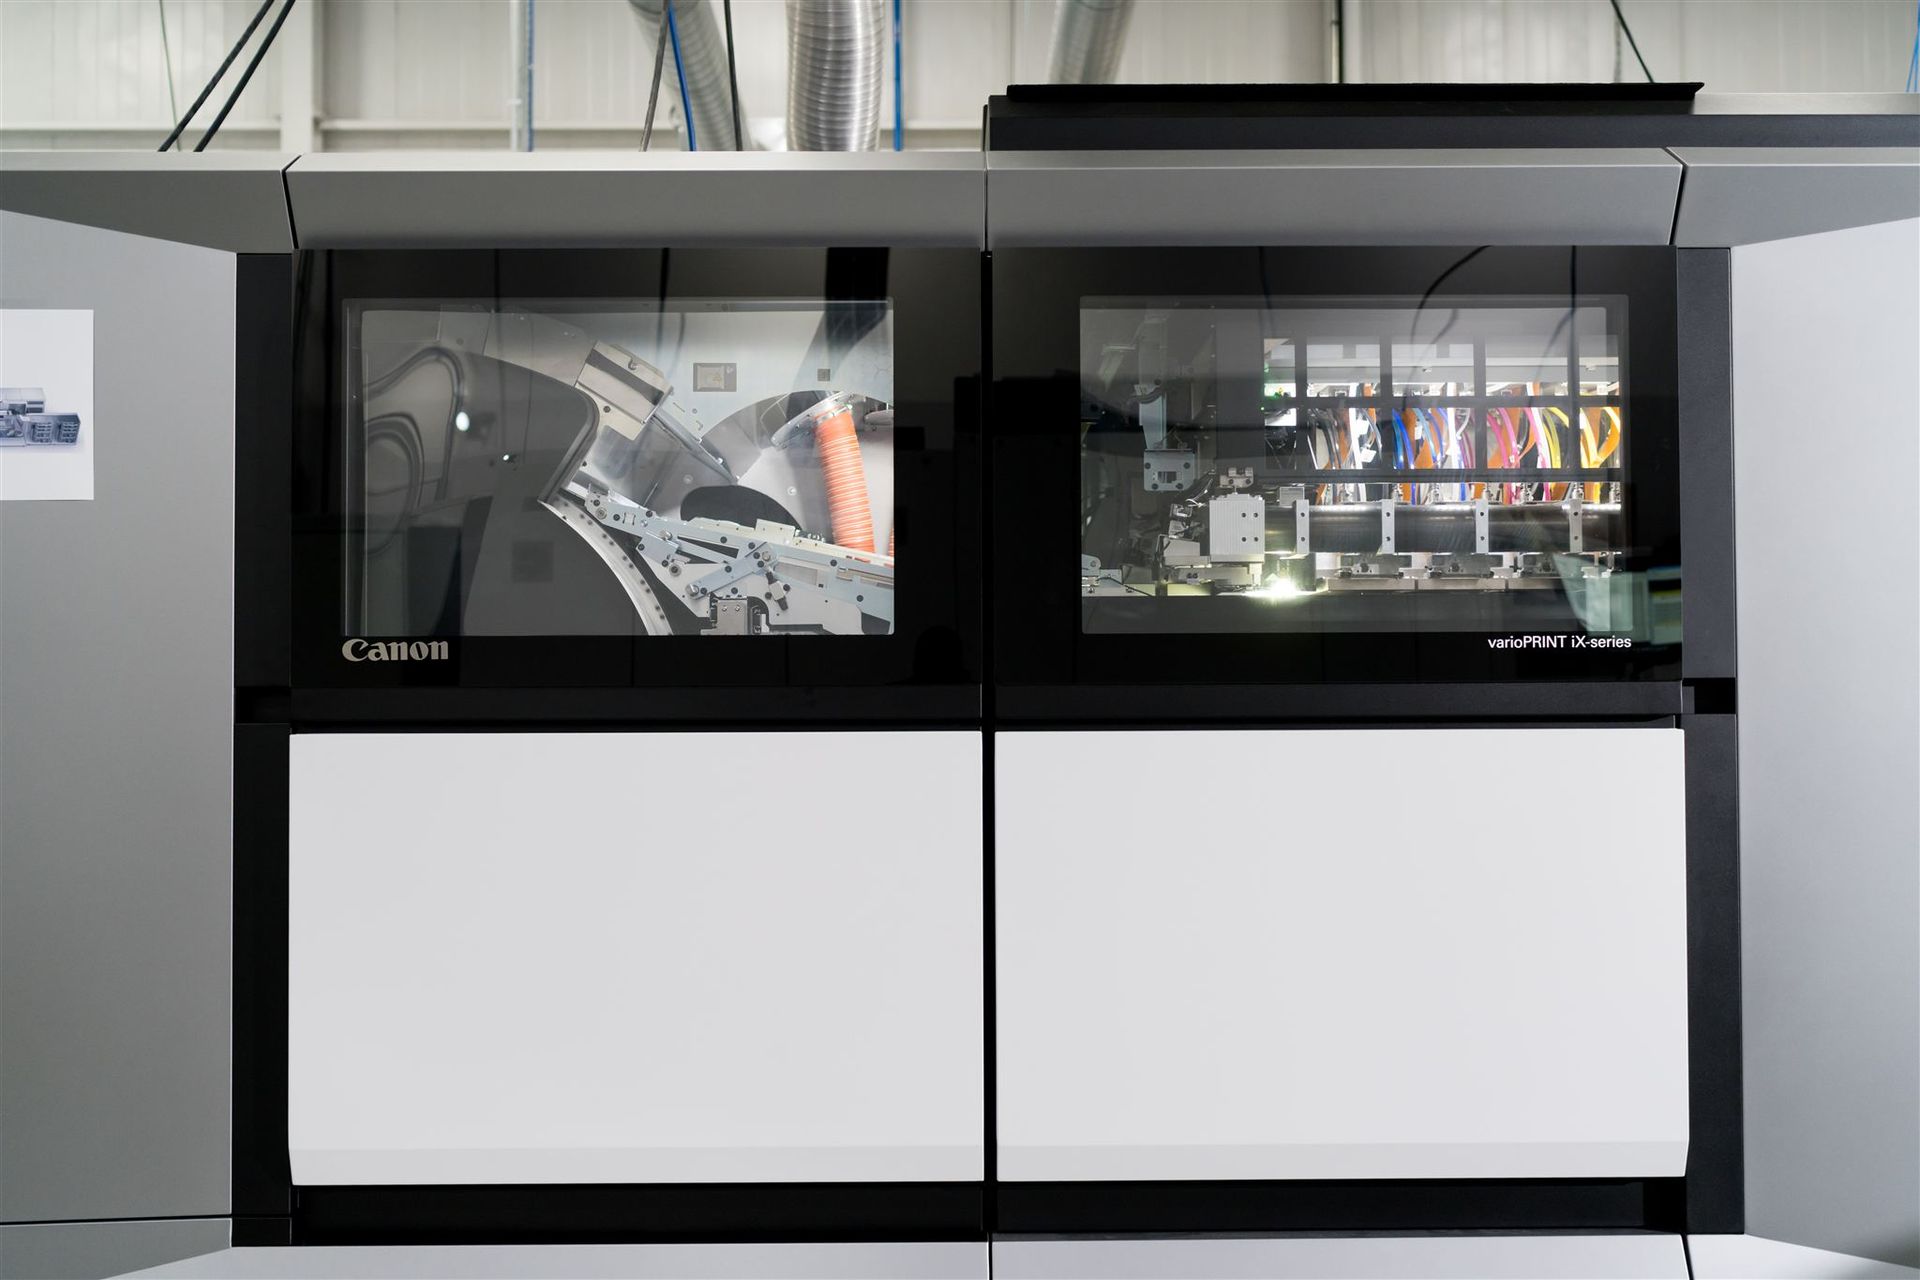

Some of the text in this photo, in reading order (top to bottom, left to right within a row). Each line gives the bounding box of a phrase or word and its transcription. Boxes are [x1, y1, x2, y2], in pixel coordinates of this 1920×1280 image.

[341, 638, 449, 662] Canon
[1487, 634, 1632, 649] varioPRINT iX-series
